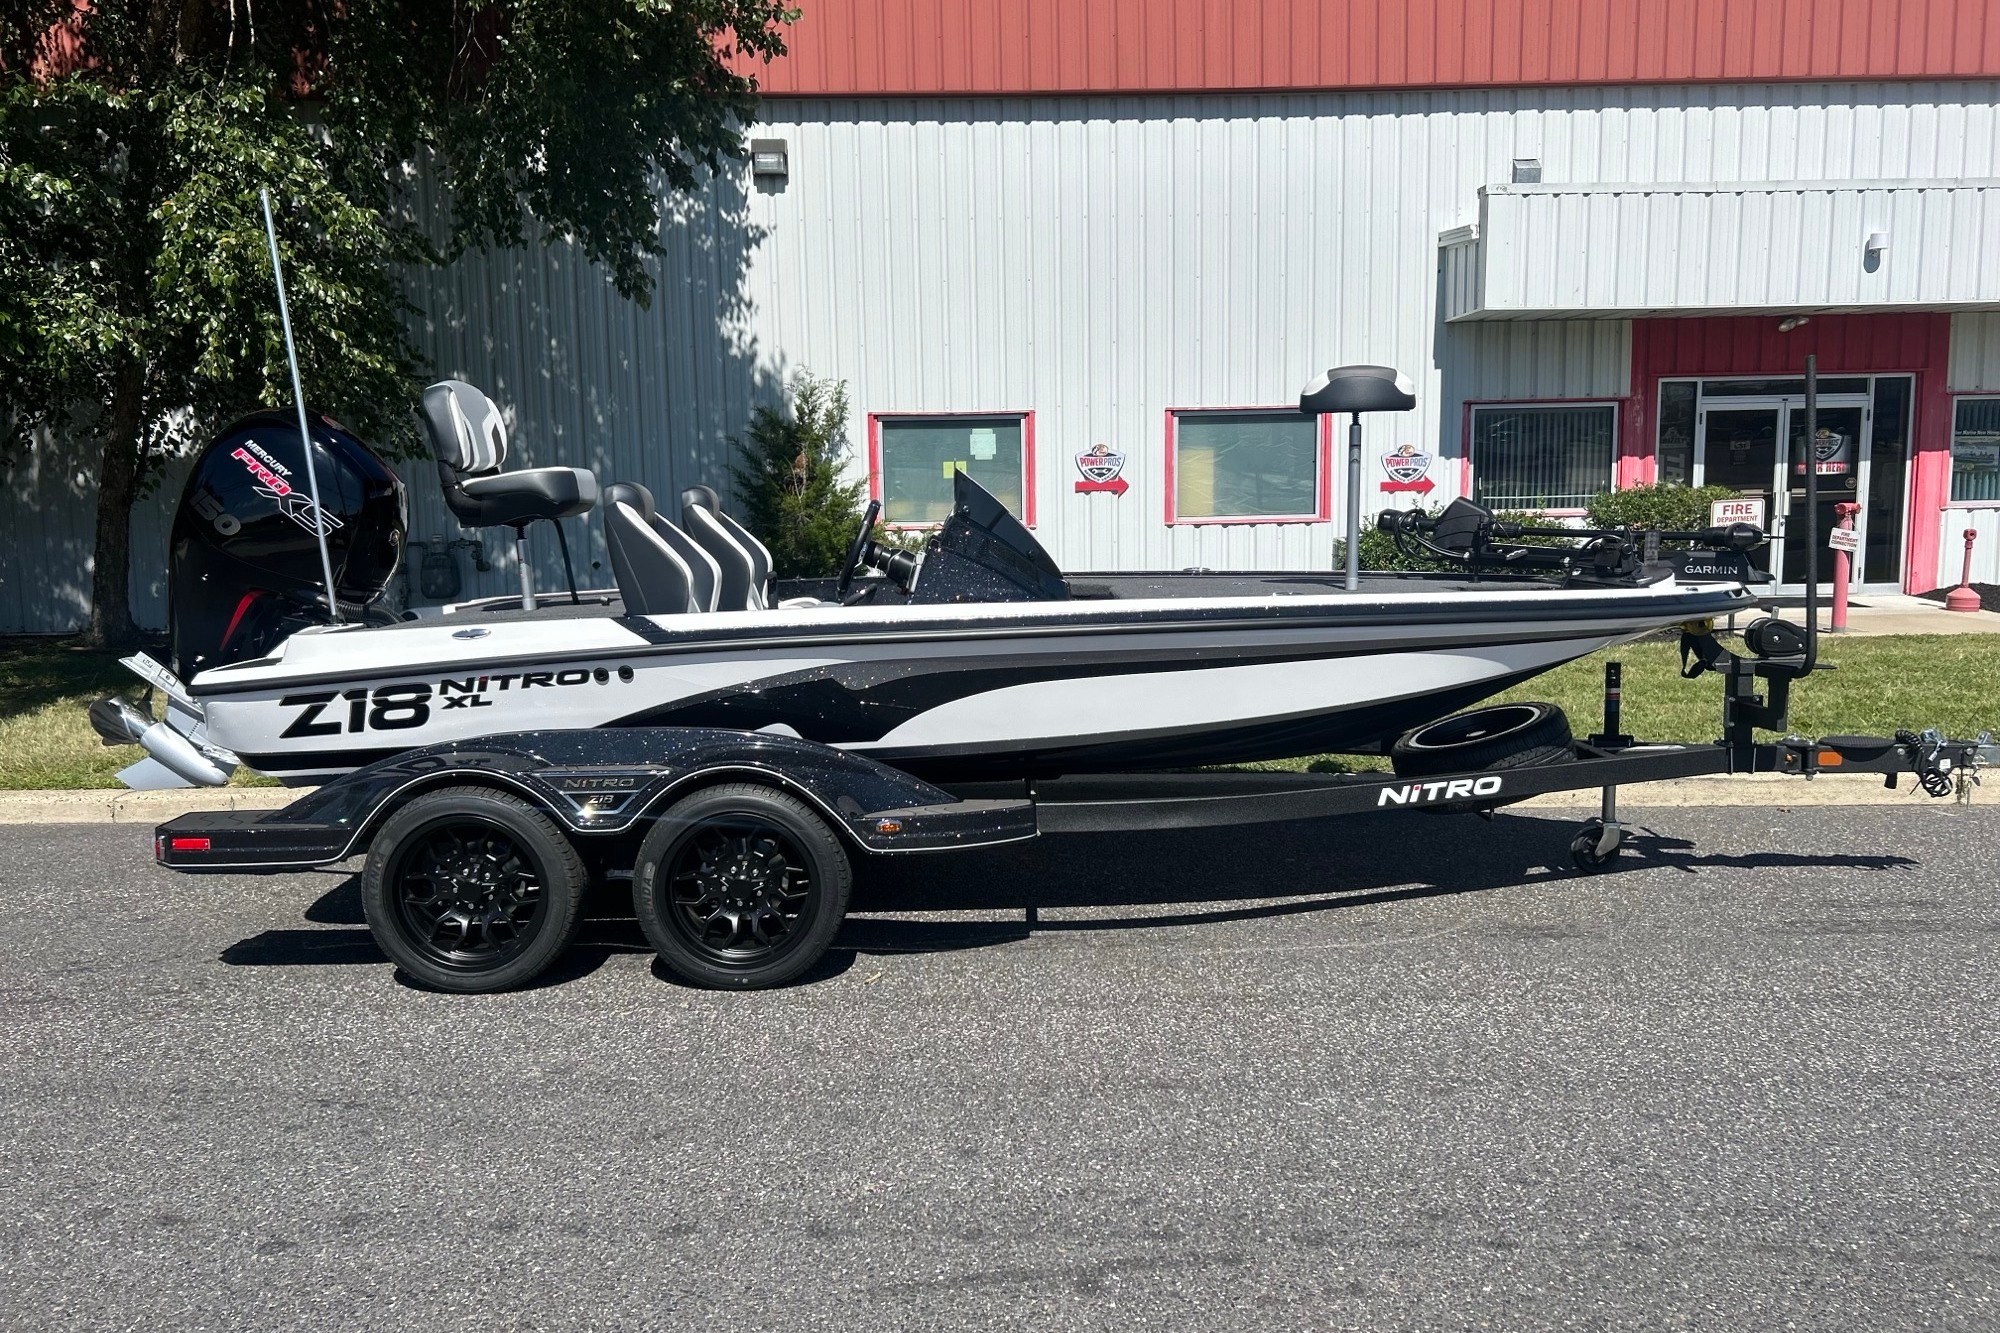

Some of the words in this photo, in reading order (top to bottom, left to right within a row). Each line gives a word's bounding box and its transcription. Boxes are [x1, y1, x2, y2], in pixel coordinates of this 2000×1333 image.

[244, 439, 293, 477] MERCURY
[230, 447, 292, 497] PRO
[1722, 503, 1753, 515] FIRE
[1716, 515, 1758, 523] DEPARTMENT
[1684, 565, 1738, 575] GARMIN
[441, 693, 493, 710] XL
[278, 681, 433, 740] Z18
[587, 794, 614, 804] Z18
